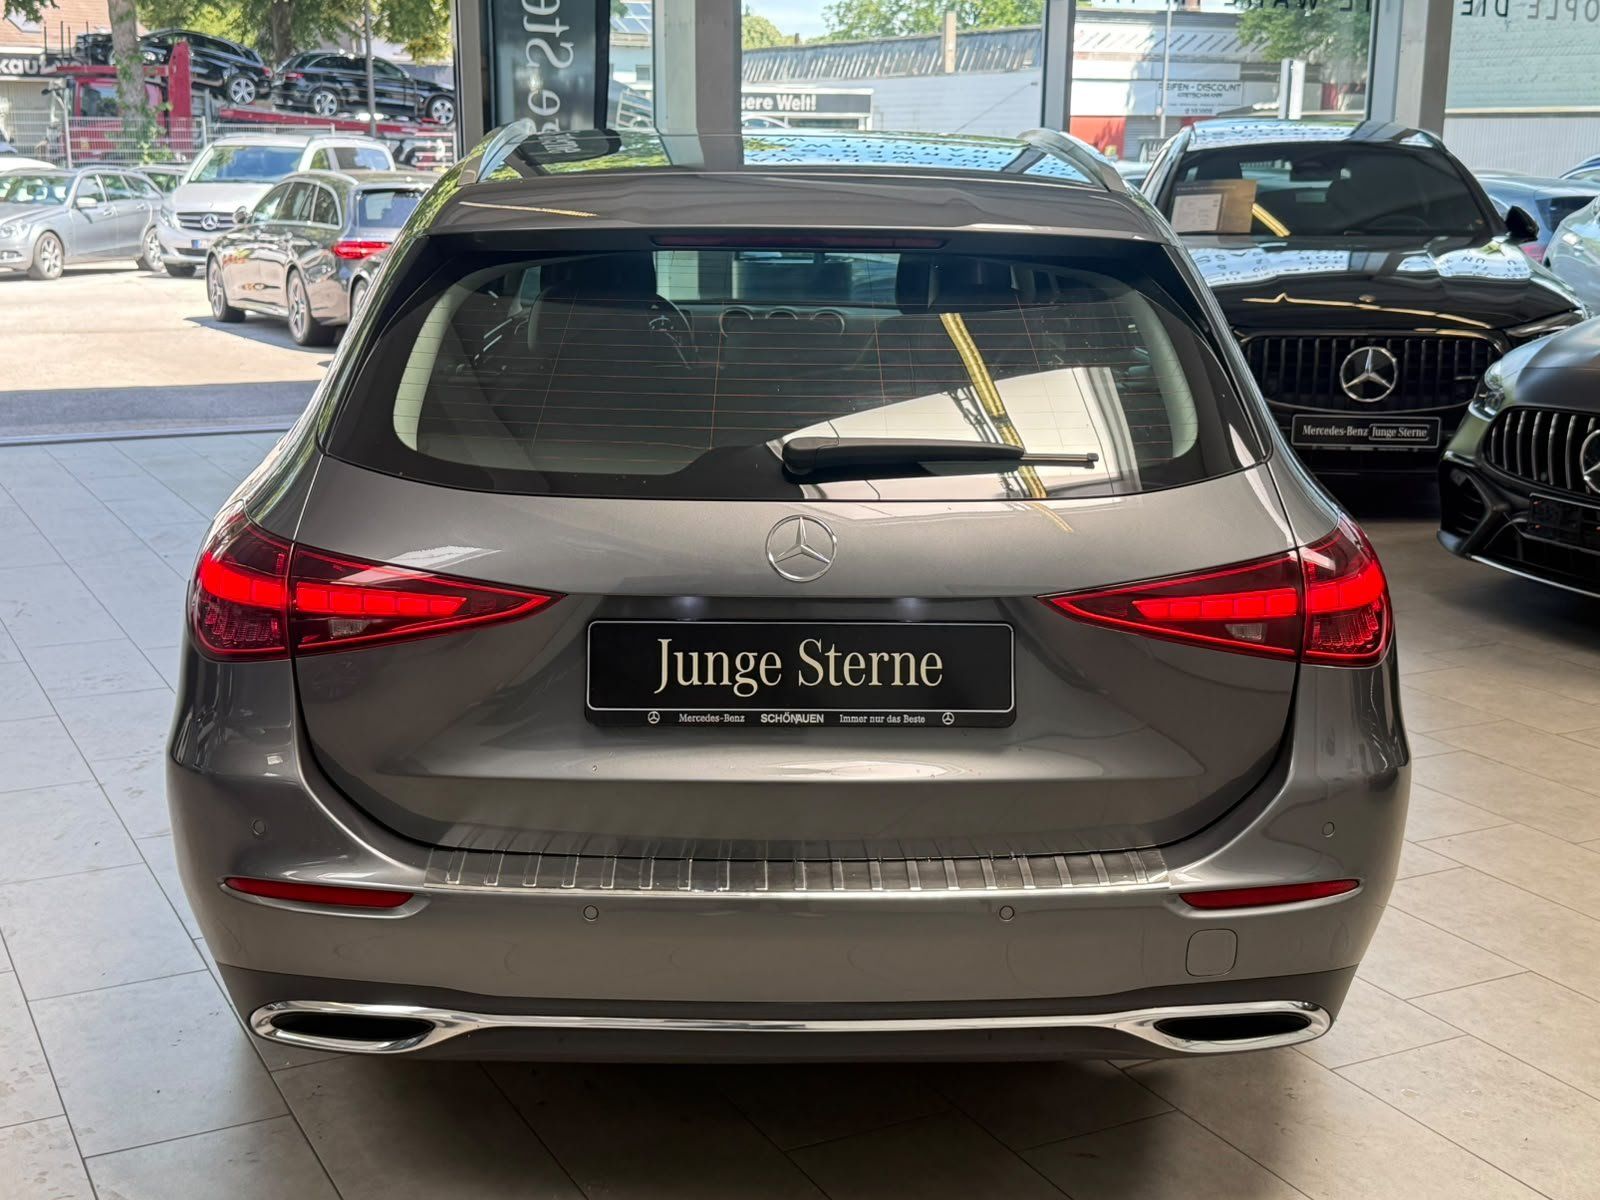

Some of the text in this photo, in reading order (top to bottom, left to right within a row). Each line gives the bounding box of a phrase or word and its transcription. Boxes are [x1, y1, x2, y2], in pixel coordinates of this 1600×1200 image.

[1196, 83, 1241, 92] DISCOUNT
[776, 94, 817, 111] Welt!
[1302, 425, 1428, 438] Mercedes-Benz Junge Sterne
[653, 638, 943, 698] Junge Sterne
[678, 712, 926, 724] Mercedes-Benz SCHÖNAUEN Immer nur das Beste
